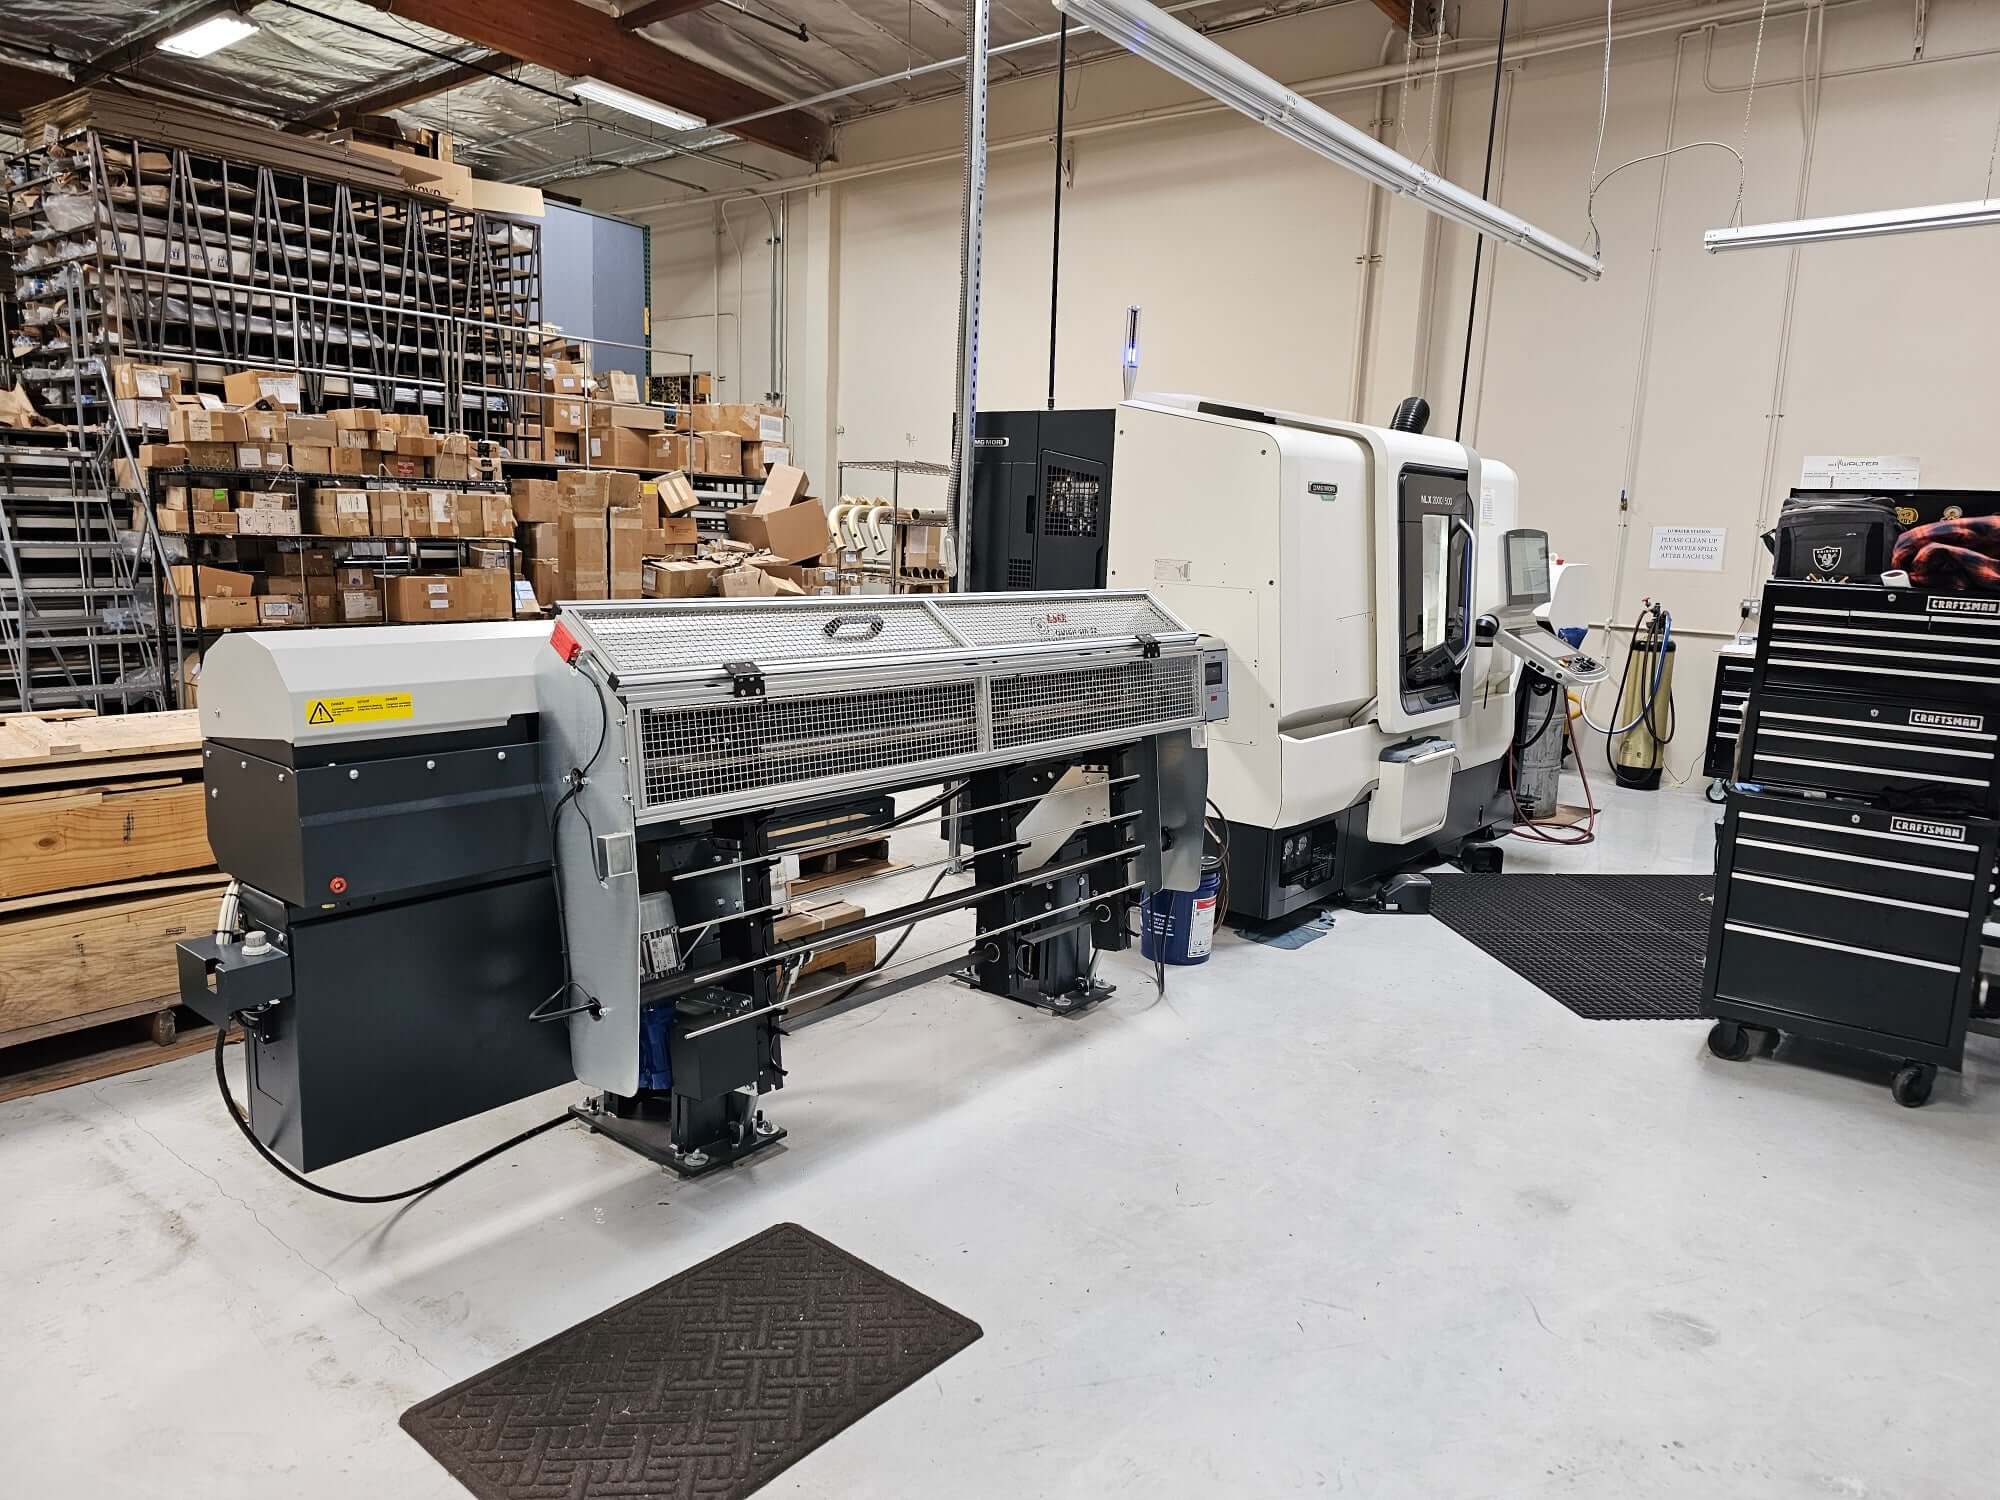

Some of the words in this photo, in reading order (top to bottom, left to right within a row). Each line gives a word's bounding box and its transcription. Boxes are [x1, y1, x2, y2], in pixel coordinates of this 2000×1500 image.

[1421, 495, 1432, 504] NLX
[1931, 599, 1997, 612] CRAFTSMAN
[1914, 713, 1978, 728] CRAFTSMAN
[1895, 820, 1960, 838] CRAFTSMAN
